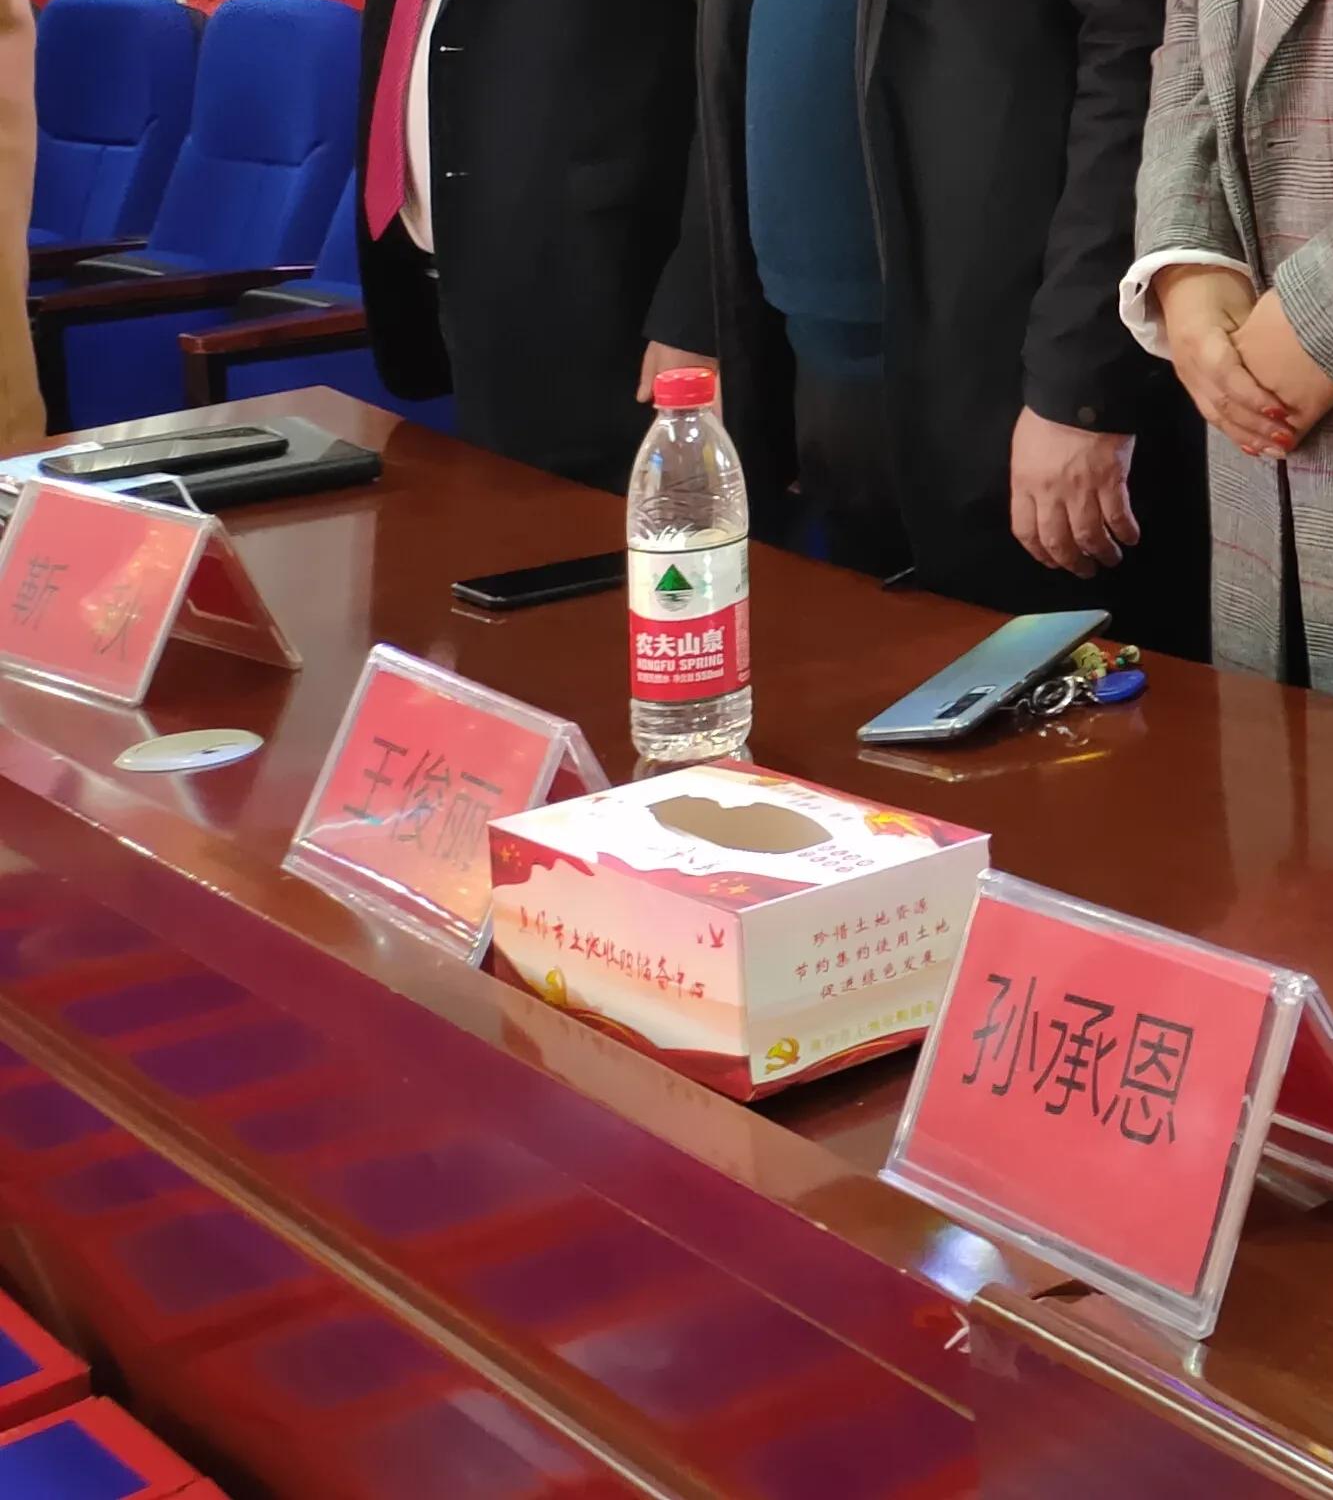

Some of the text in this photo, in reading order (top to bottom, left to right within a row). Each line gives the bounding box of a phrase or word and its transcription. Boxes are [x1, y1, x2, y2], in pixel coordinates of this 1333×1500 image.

[635, 629, 724, 658] 农夫山泉
[678, 652, 724, 672] SPRING
[342, 735, 503, 872] 王俊丽
[812, 897, 930, 948] 珍惜土地资源
[794, 918, 951, 981] 节约集约使用土地
[819, 949, 937, 1000] 促进绿色发展
[961, 973, 1195, 1146] 孙承恩
